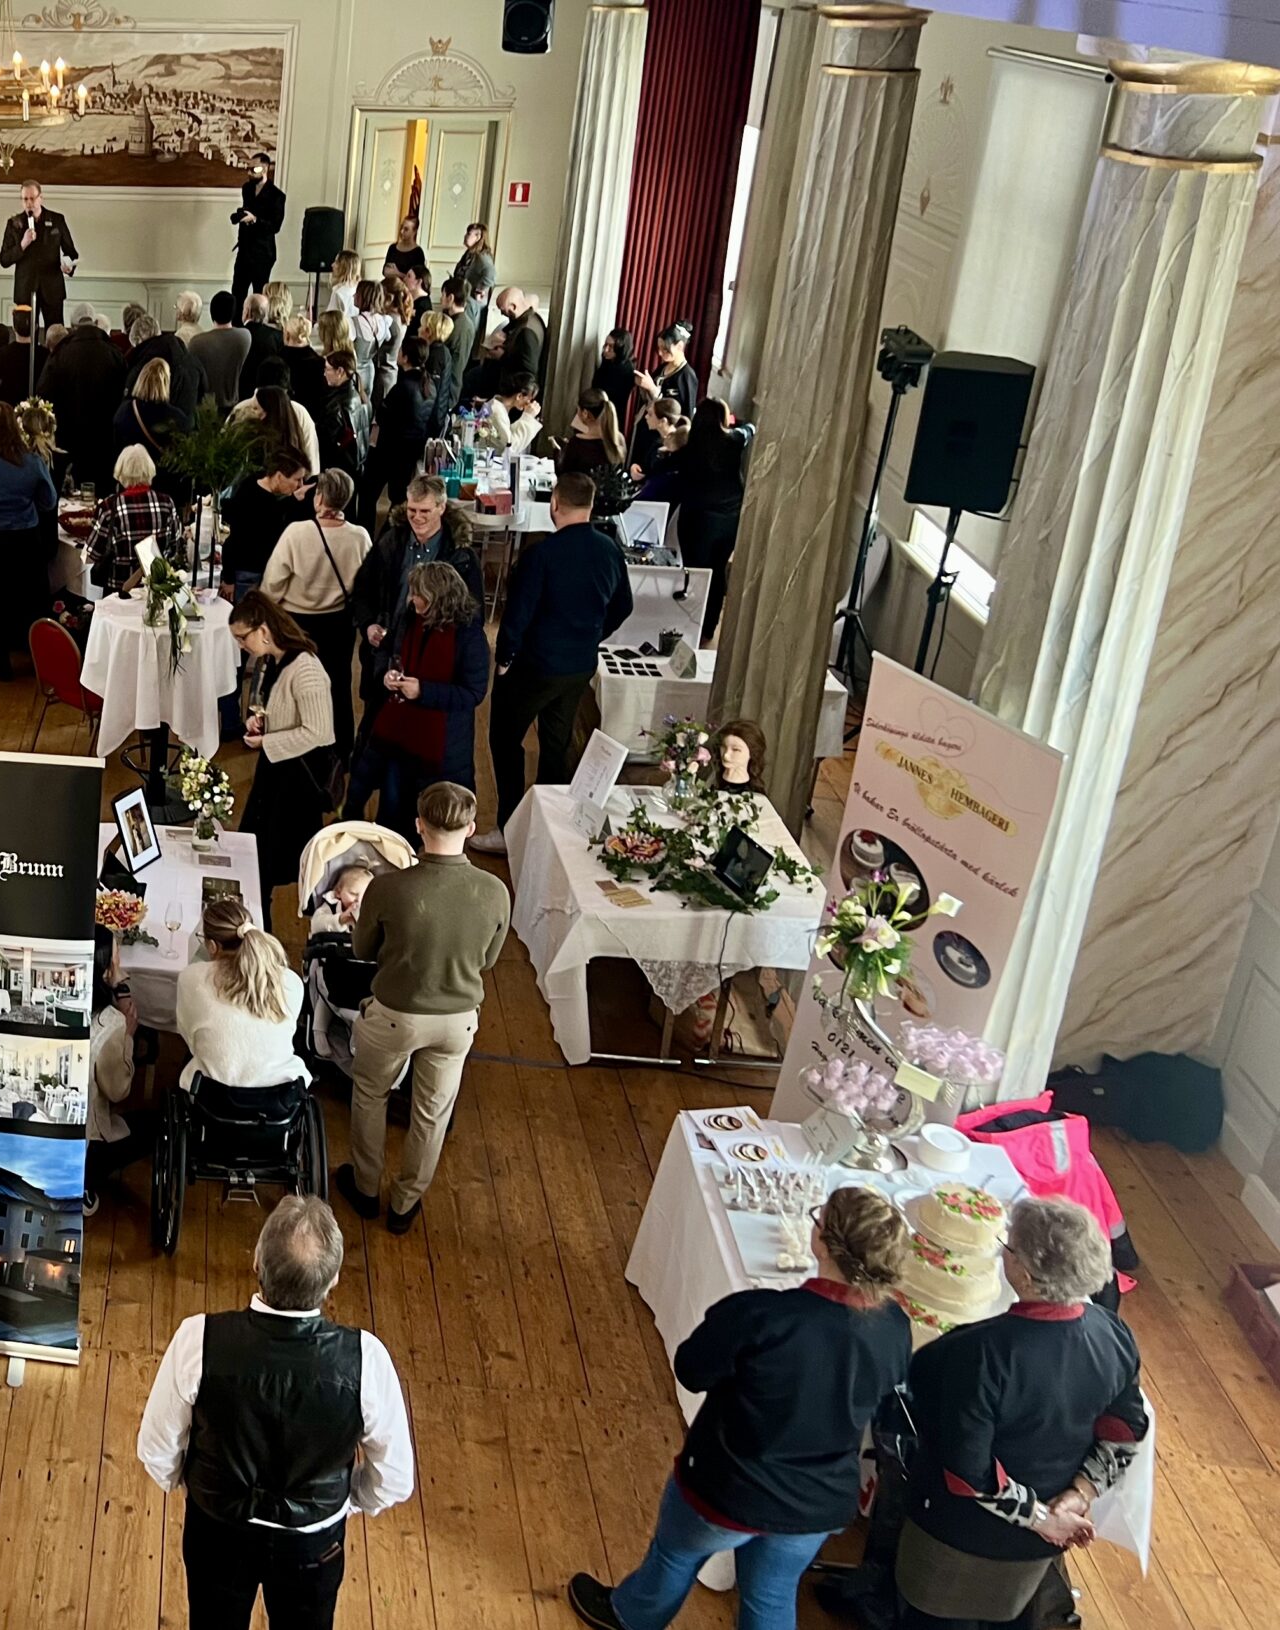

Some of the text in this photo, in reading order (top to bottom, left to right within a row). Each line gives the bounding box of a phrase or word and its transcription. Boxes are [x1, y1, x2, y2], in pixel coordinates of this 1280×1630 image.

[897, 756, 1011, 833] JANNES HEMBAGERI
[862, 791, 884, 813] bakar
[886, 807, 900, 822] Er
[960, 858, 980, 876] med
[982, 872, 1021, 898] kärlek
